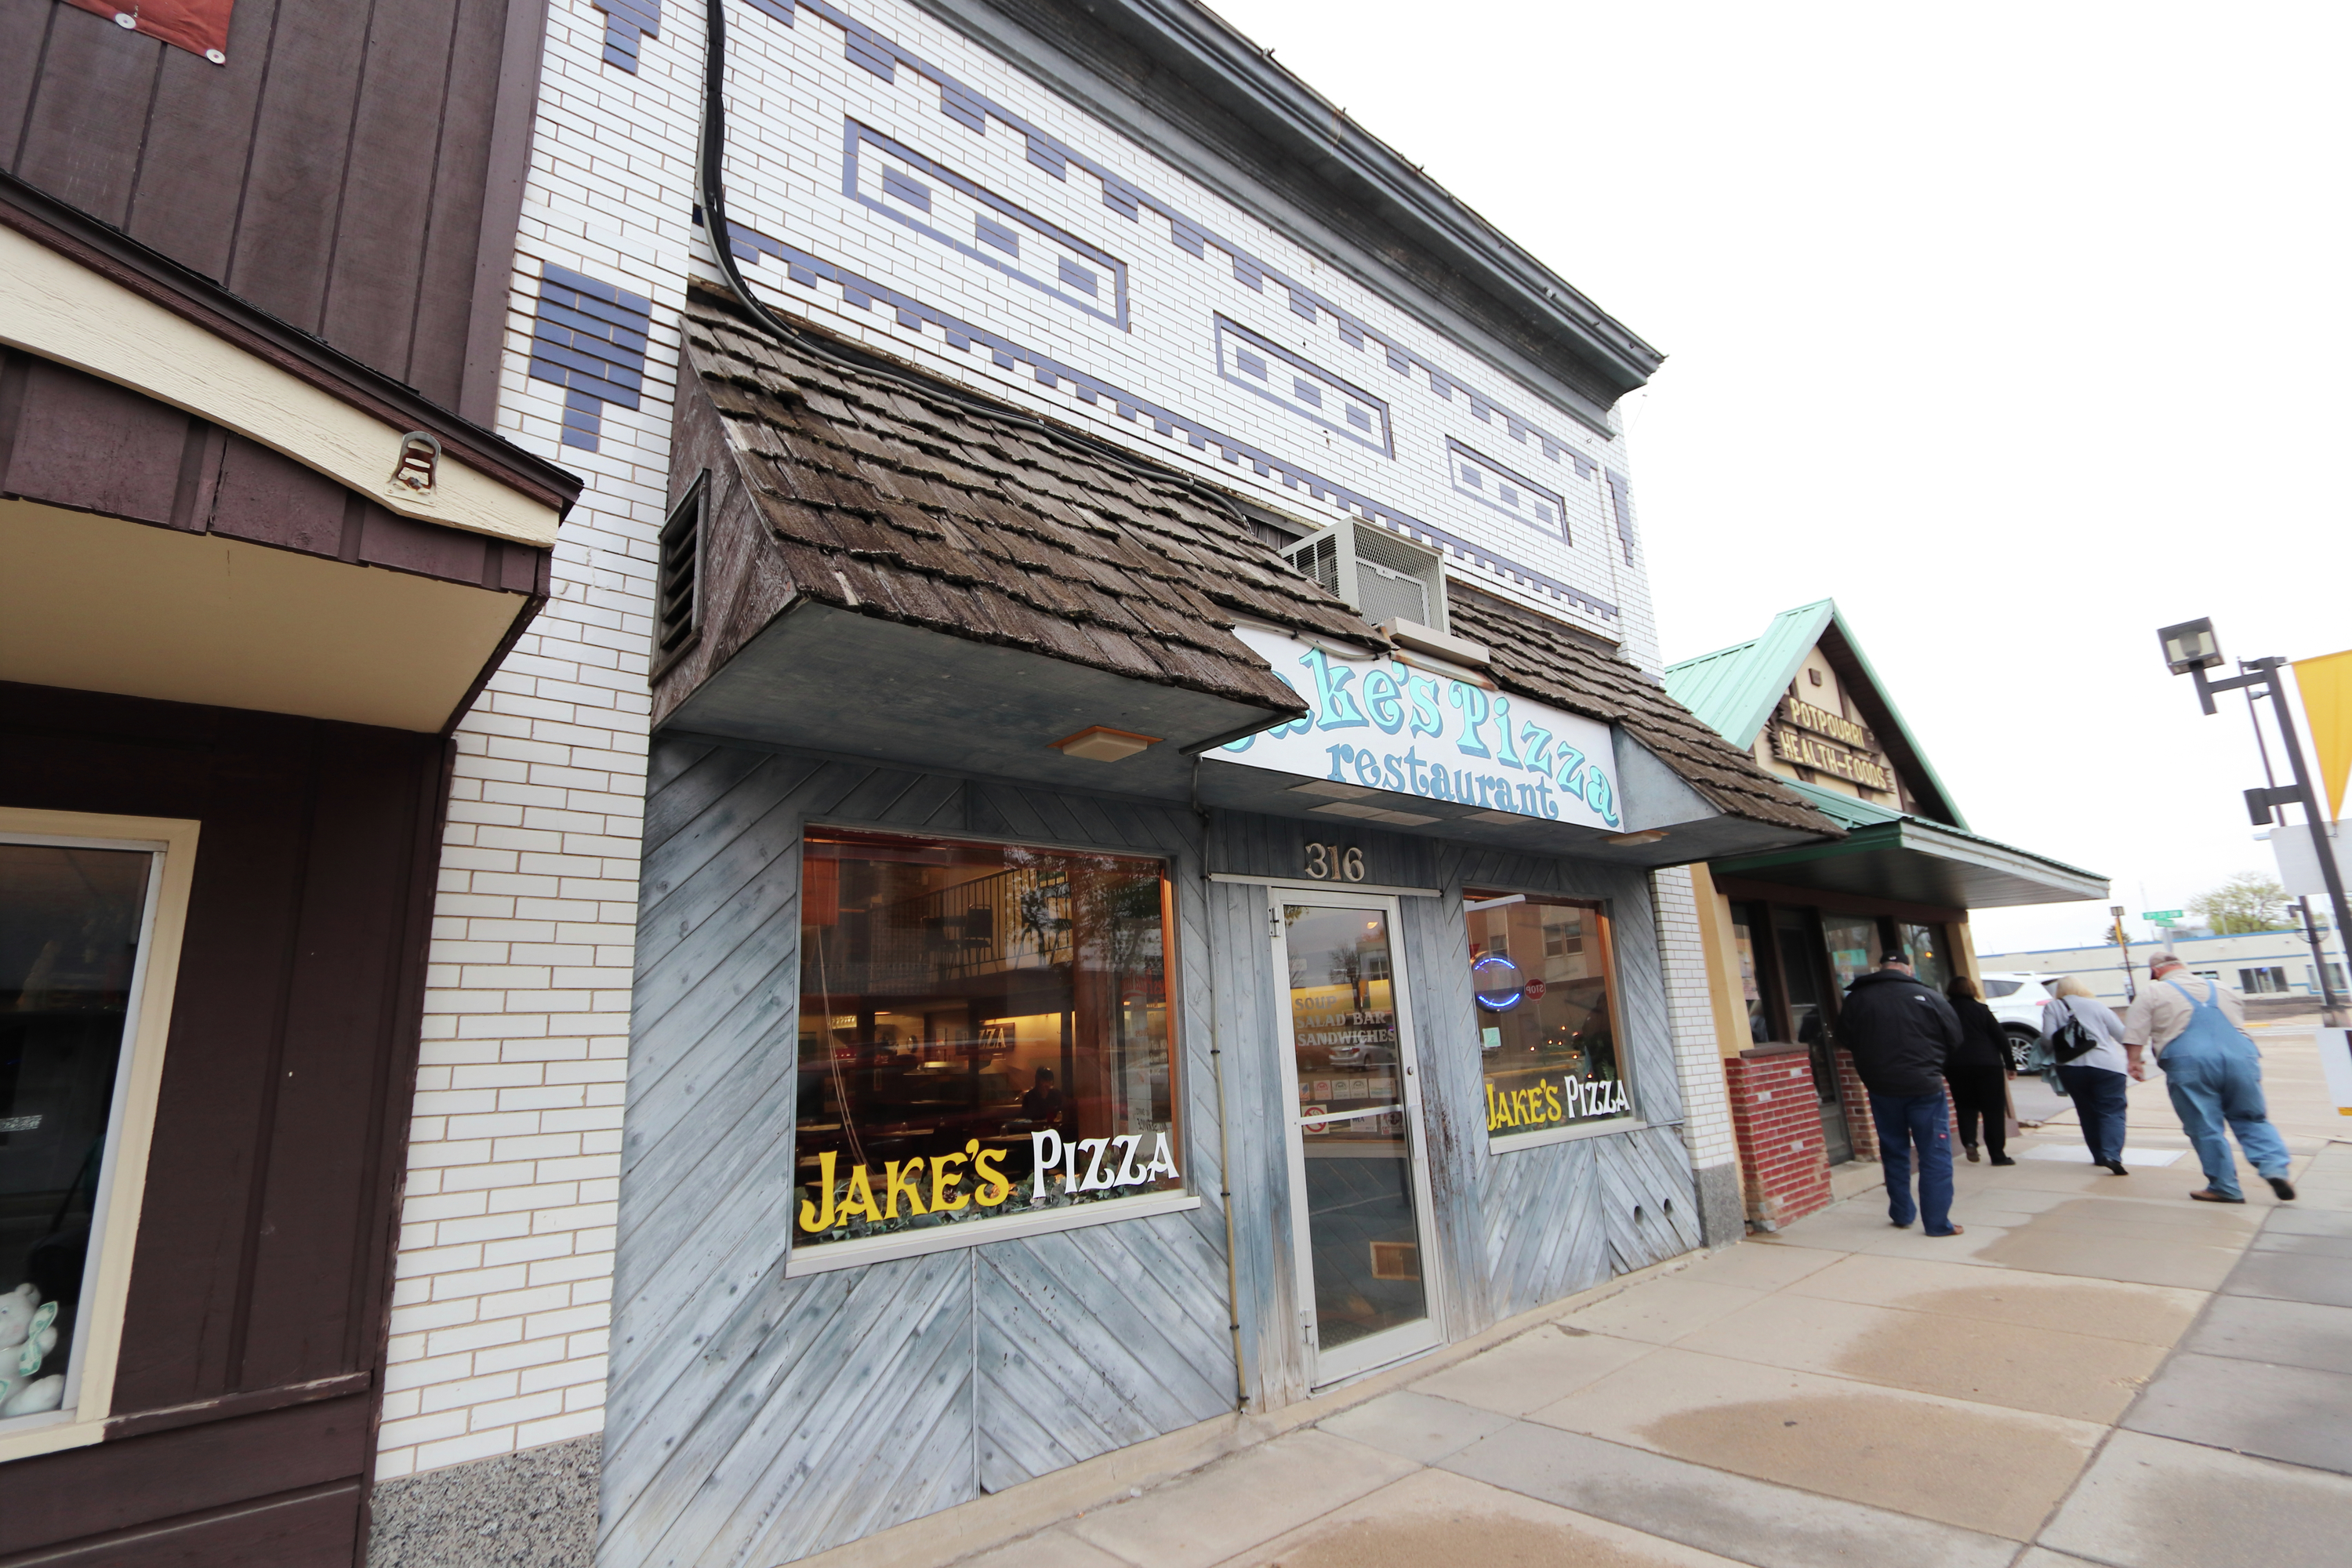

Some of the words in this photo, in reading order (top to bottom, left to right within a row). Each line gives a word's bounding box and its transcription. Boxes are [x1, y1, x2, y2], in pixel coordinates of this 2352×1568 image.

[1221, 641, 1443, 753] ke's
[1450, 677, 1620, 828] Pizza
[1789, 697, 1865, 748] POTPOURRI
[1327, 743, 1559, 821] restaurant
[1305, 842, 1365, 882] 316
[1294, 996, 1338, 1011] SOUP
[1296, 1013, 1346, 1029] SALAD
[1352, 1011, 1386, 1025] BAR
[1297, 1029, 1396, 1047] SANDWICHES
[1486, 1079, 1562, 1131] JAKE'S
[1564, 1075, 1631, 1119] PIZZA
[799, 1138, 1010, 1232] JAKE'S
[1029, 1129, 1180, 1199] PIZZA
